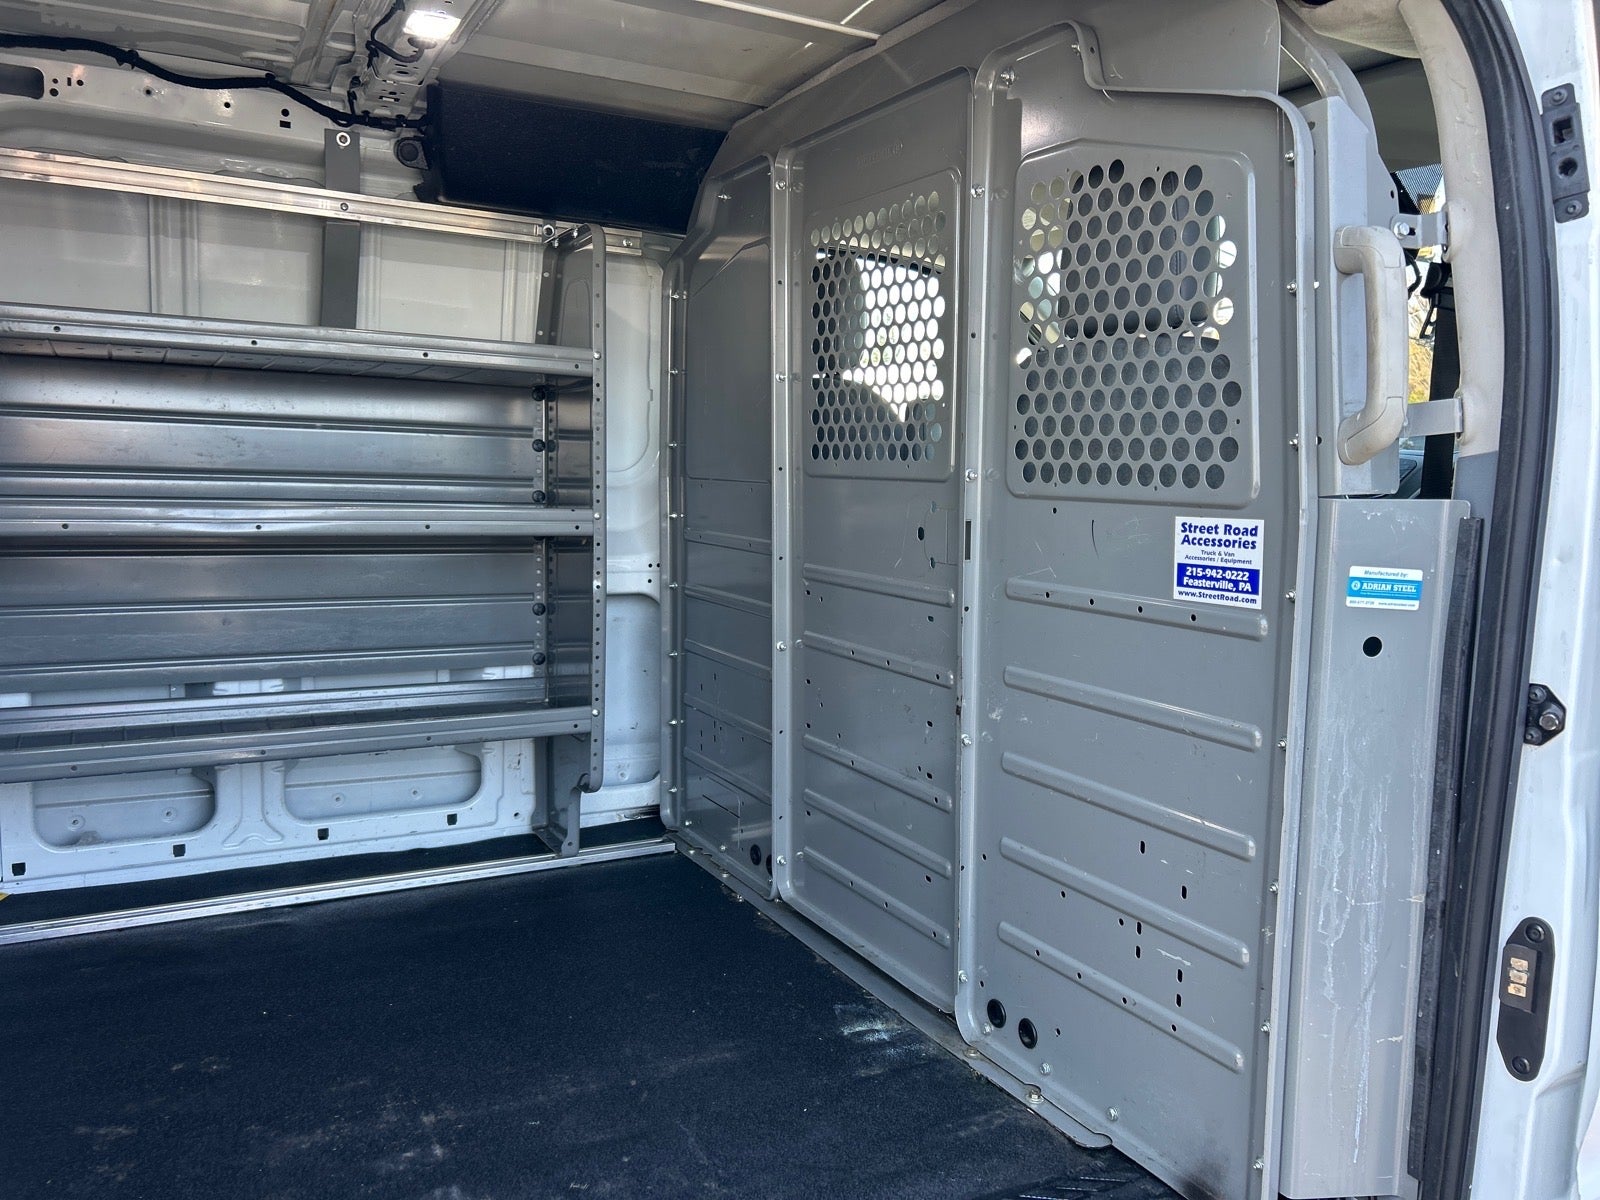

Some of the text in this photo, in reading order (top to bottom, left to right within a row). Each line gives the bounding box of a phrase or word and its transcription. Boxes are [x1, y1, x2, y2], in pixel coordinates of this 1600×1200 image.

[1181, 522, 1258, 537] Street Road
[1181, 534, 1257, 549] Accessories
[1186, 567, 1249, 580] 215-942-0222
[1183, 577, 1252, 592] Feasterville, PA
[1178, 590, 1257, 604] www.StreetRoad.com
